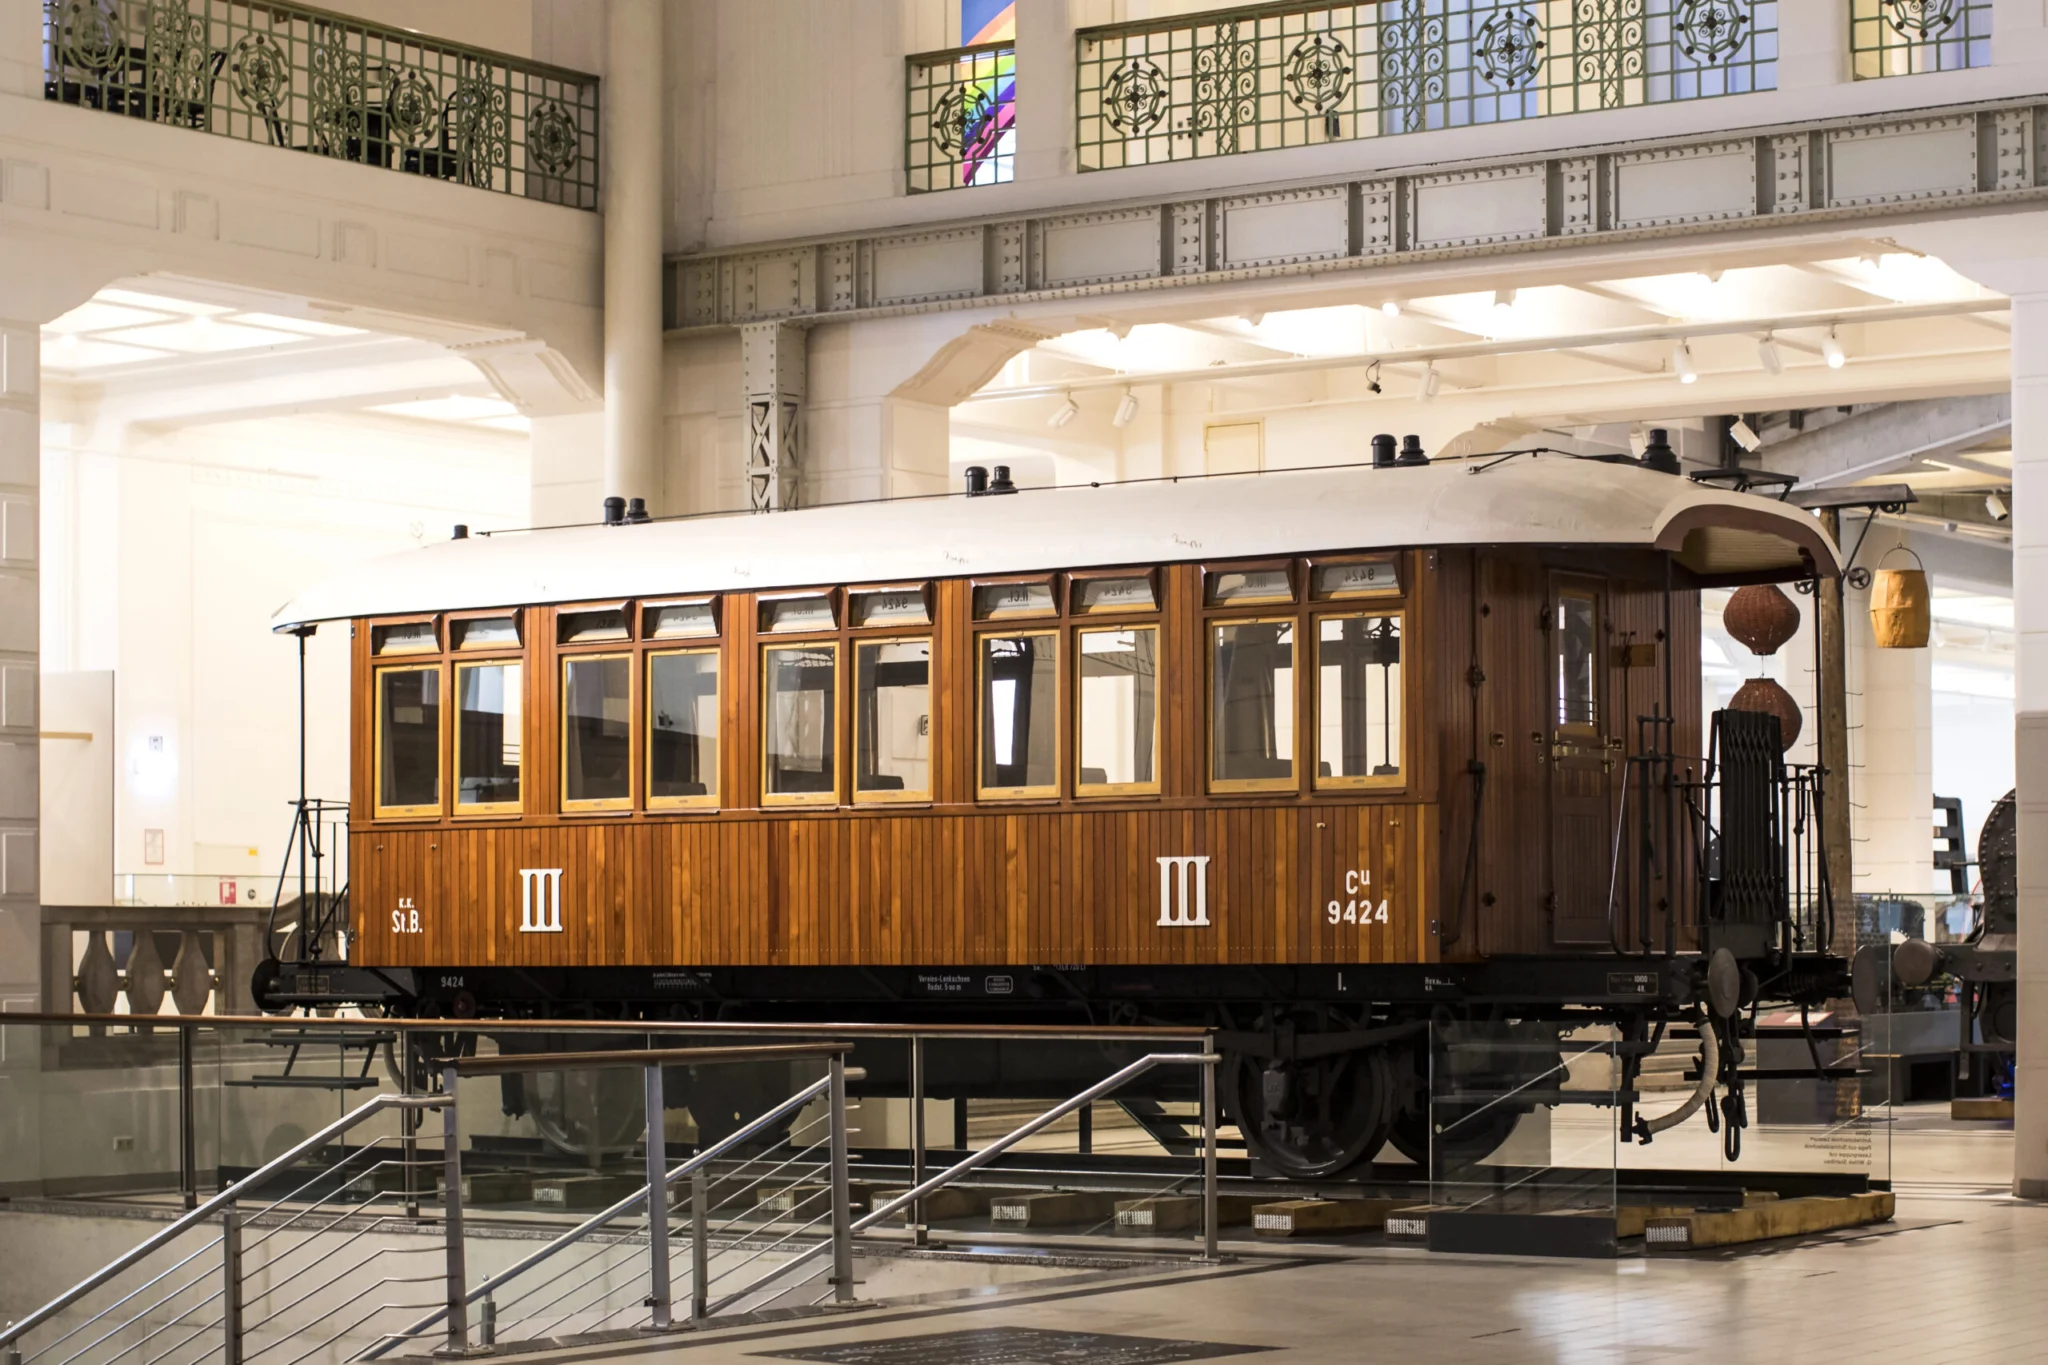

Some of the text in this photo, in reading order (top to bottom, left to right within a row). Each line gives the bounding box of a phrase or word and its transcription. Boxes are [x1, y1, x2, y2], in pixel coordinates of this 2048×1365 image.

[1156, 856, 1210, 926] III
[1346, 869, 1371, 894] Cu
[519, 868, 563, 932] III
[1328, 899, 1389, 925] 9424
[392, 909, 423, 934] St.B.
[440, 975, 464, 988] 9424
